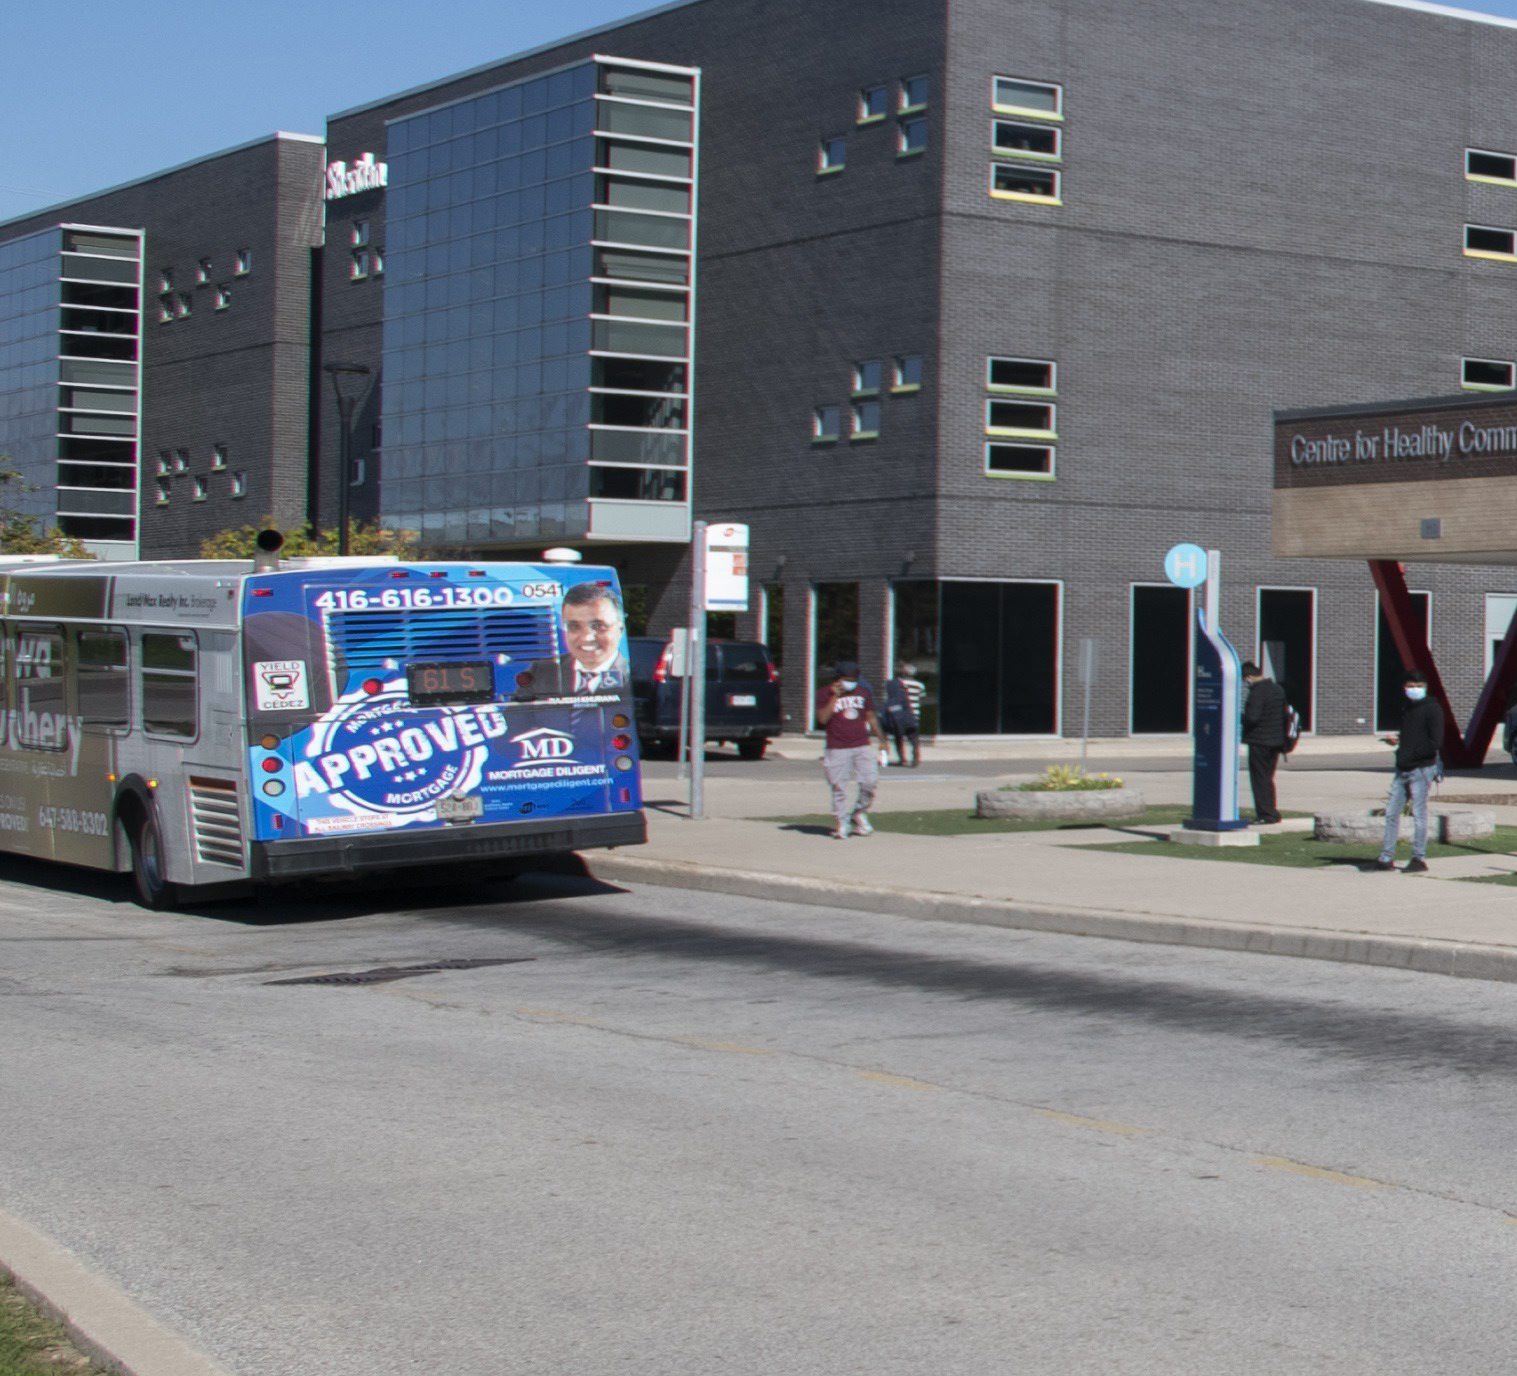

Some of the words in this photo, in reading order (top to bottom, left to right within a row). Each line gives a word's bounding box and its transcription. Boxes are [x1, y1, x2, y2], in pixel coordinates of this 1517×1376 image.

[1291, 434, 1350, 465] Centre
[1355, 429, 1380, 460] for
[1384, 424, 1454, 461] Healthy
[1174, 552, 1197, 578] H
[315, 587, 513, 609] 416-616-1300
[522, 584, 565, 598] 0541
[260, 662, 300, 671] YIELD
[423, 668, 449, 690] 61
[833, 696, 865, 712] NIKE
[293, 705, 508, 798] APPROVED
[520, 737, 574, 759] MD
[488, 767, 554, 781] MORTGAGE
[556, 764, 607, 777] DILIGENT
[385, 764, 459, 804] MORTGAGE
[480, 777, 614, 792] www.mortgagediligent.com
